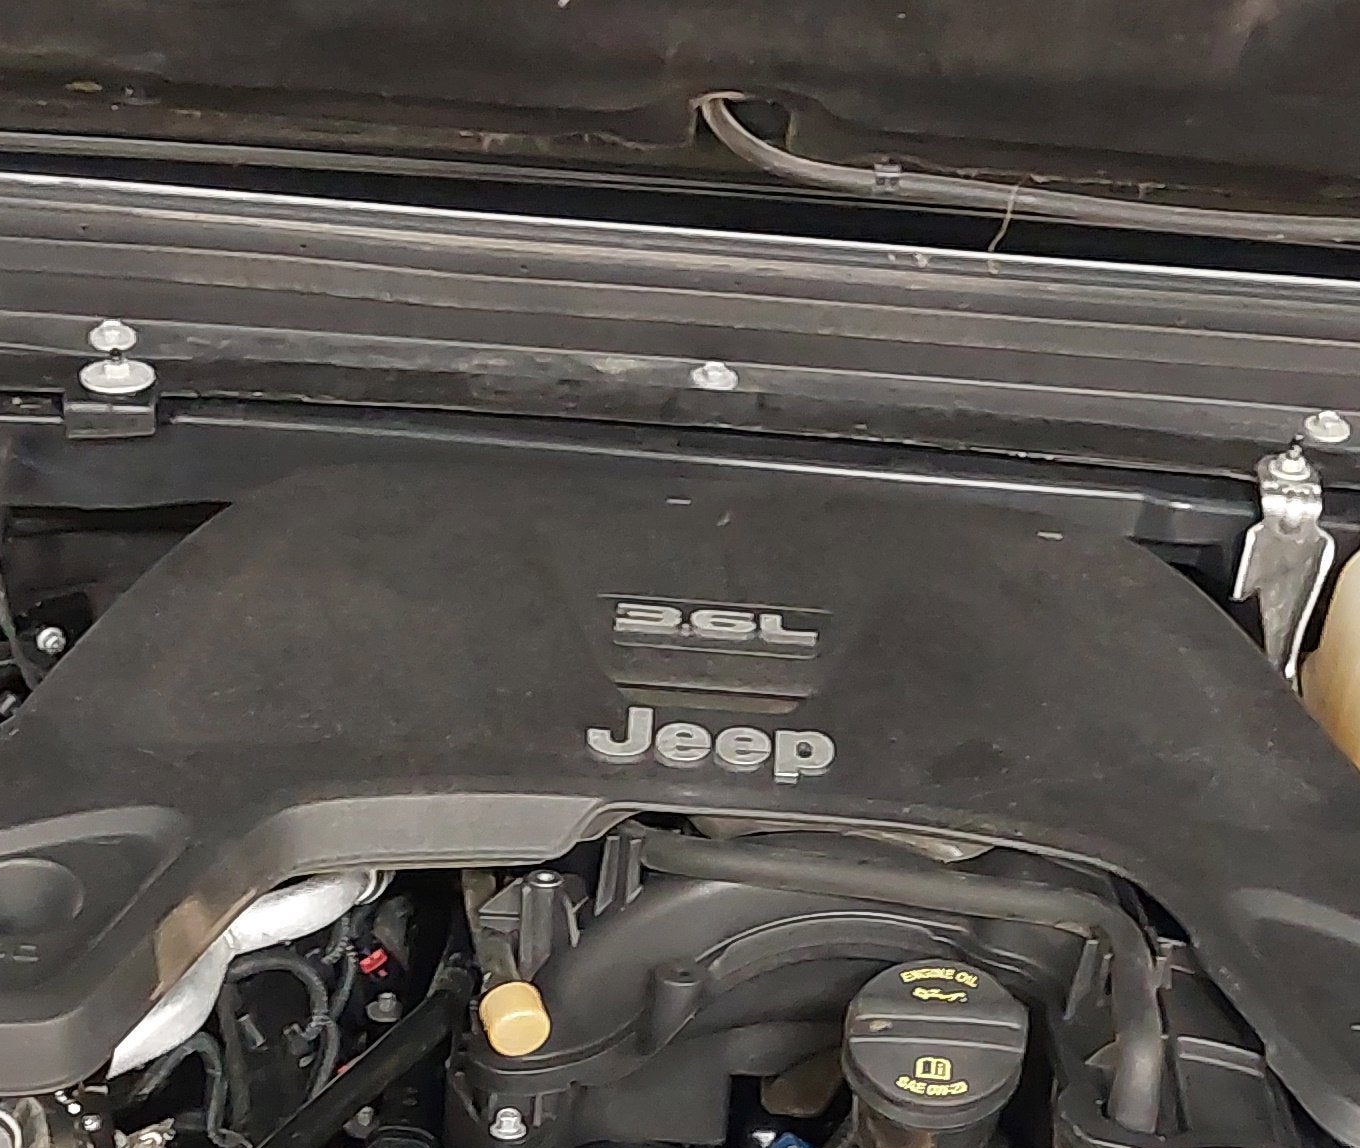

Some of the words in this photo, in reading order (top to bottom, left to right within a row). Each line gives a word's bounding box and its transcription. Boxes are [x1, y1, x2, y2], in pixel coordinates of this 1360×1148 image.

[614, 602, 819, 647] 3.6L
[586, 706, 836, 784] Jeep
[899, 967, 956, 984] ENGINE
[955, 970, 980, 988] OIL
[895, 1075, 925, 1093] SAE
